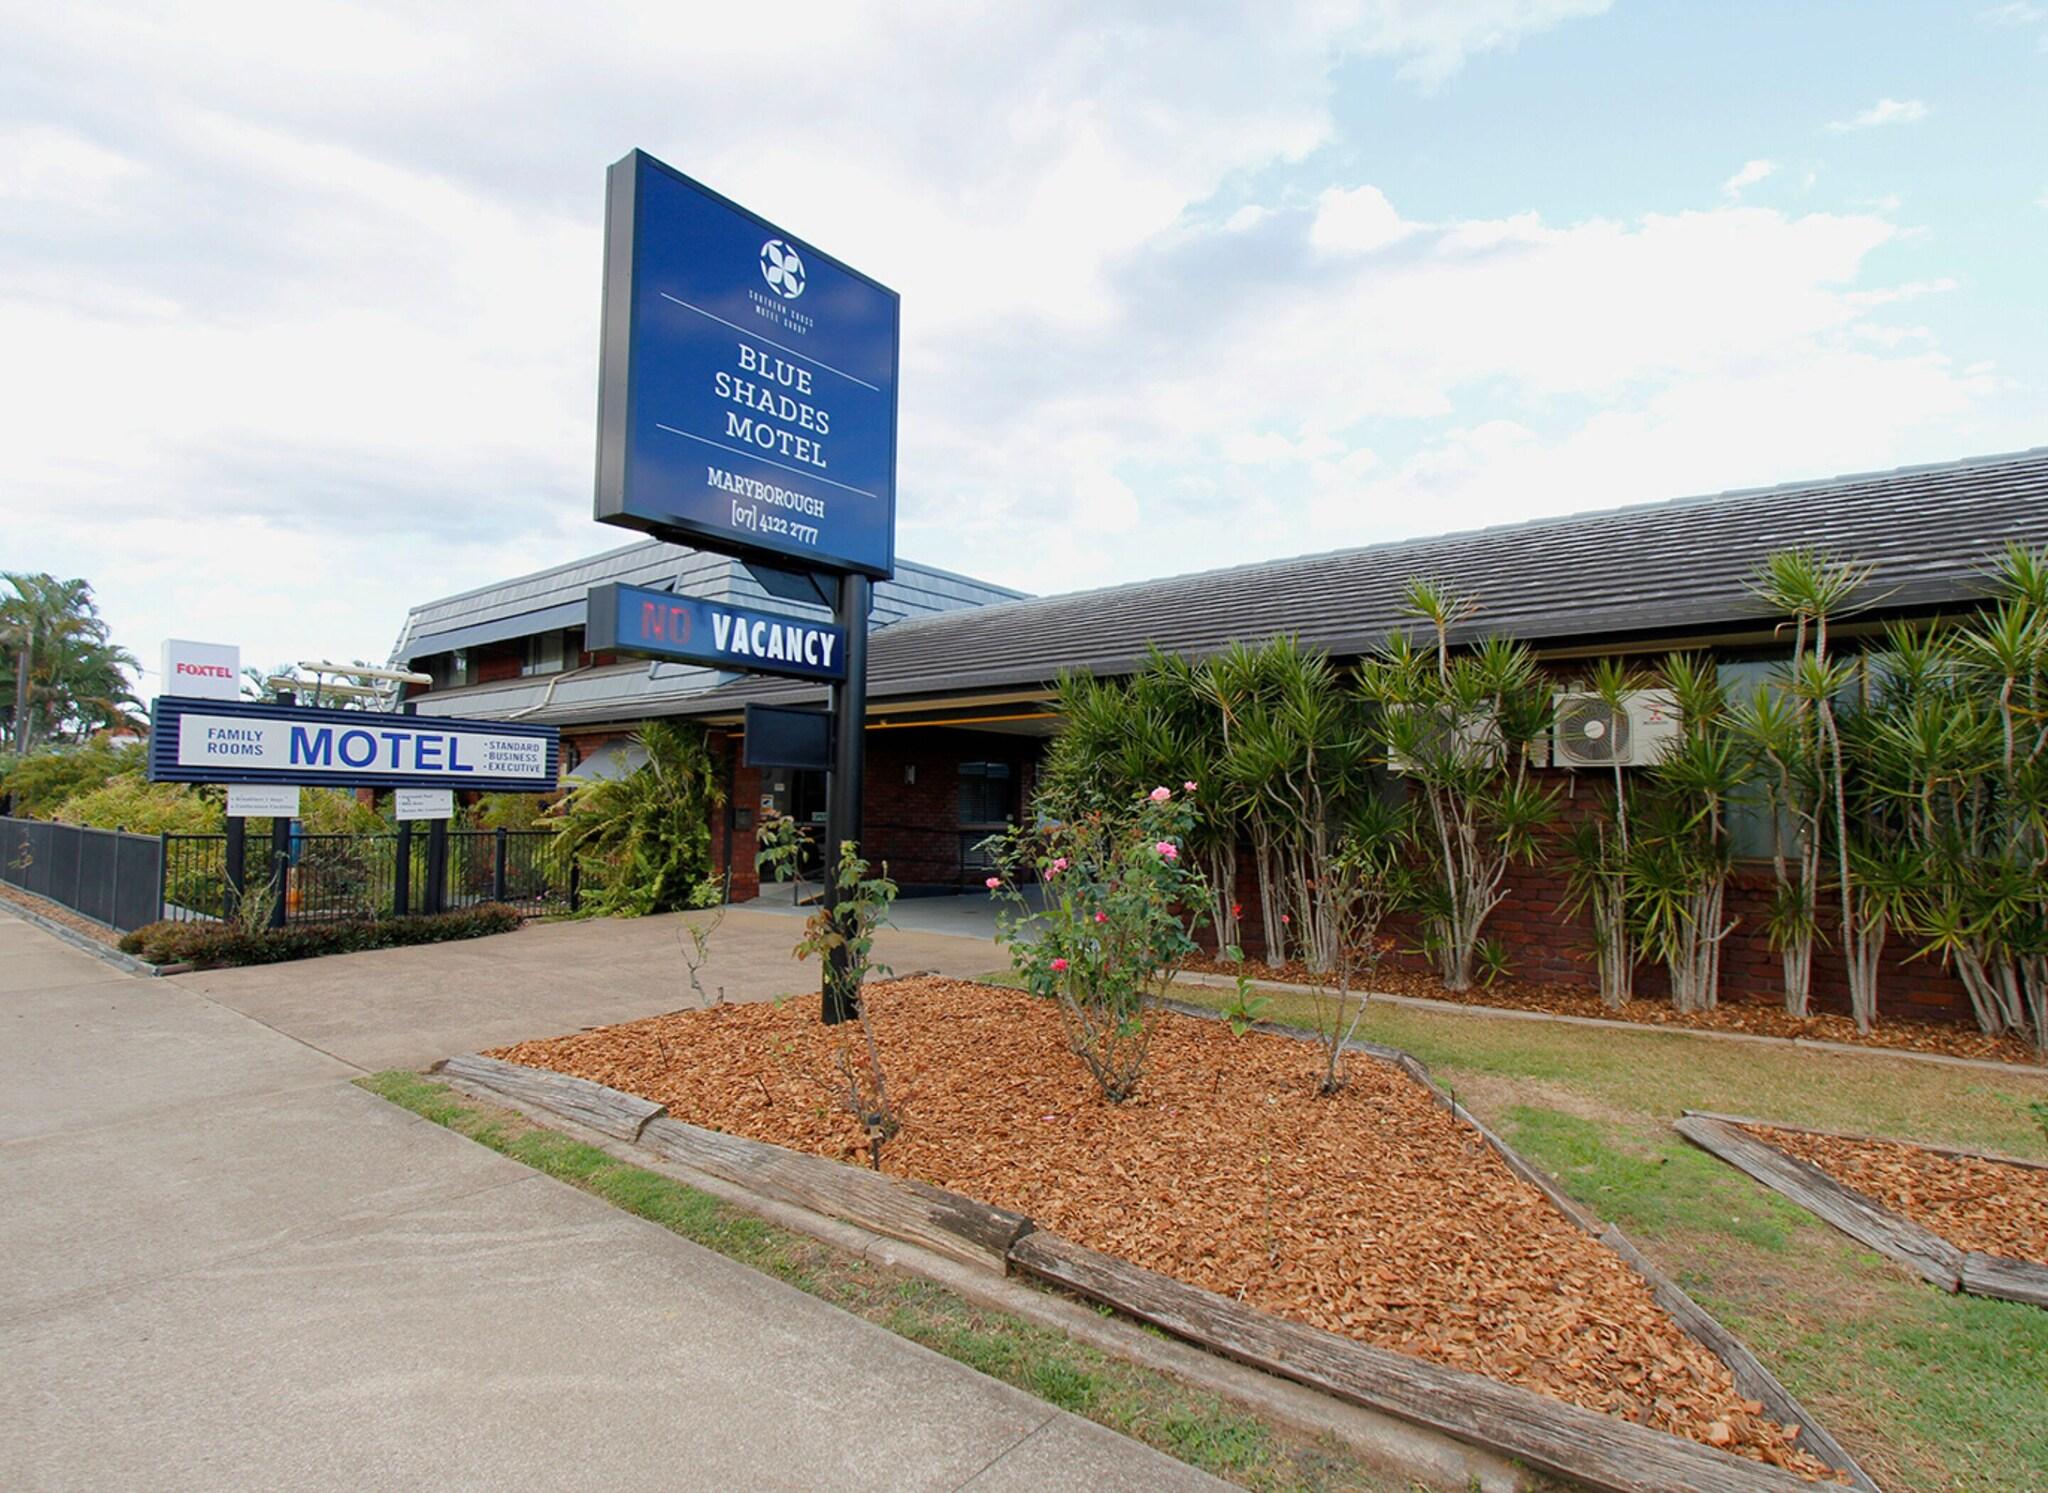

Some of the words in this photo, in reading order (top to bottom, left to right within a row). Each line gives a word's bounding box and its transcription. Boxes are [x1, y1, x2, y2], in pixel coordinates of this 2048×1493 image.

[738, 342, 813, 396] BLUE
[714, 371, 830, 435] SHADES
[725, 411, 828, 468] MOTEL
[707, 466, 825, 519] MARYBOROUGH
[759, 510, 788, 535] 4122
[789, 519, 819, 545] 2777
[640, 600, 691, 645] NO
[711, 613, 837, 667] VACANCY
[176, 662, 233, 679] FOXTEL
[207, 727, 264, 743] FAMILY
[207, 741, 264, 757] ROOMS
[290, 726, 474, 772] MOTEL
[488, 740, 540, 753] STANDARD
[488, 751, 539, 763] BUSINESS
[488, 762, 541, 774] EXECUTIVE
